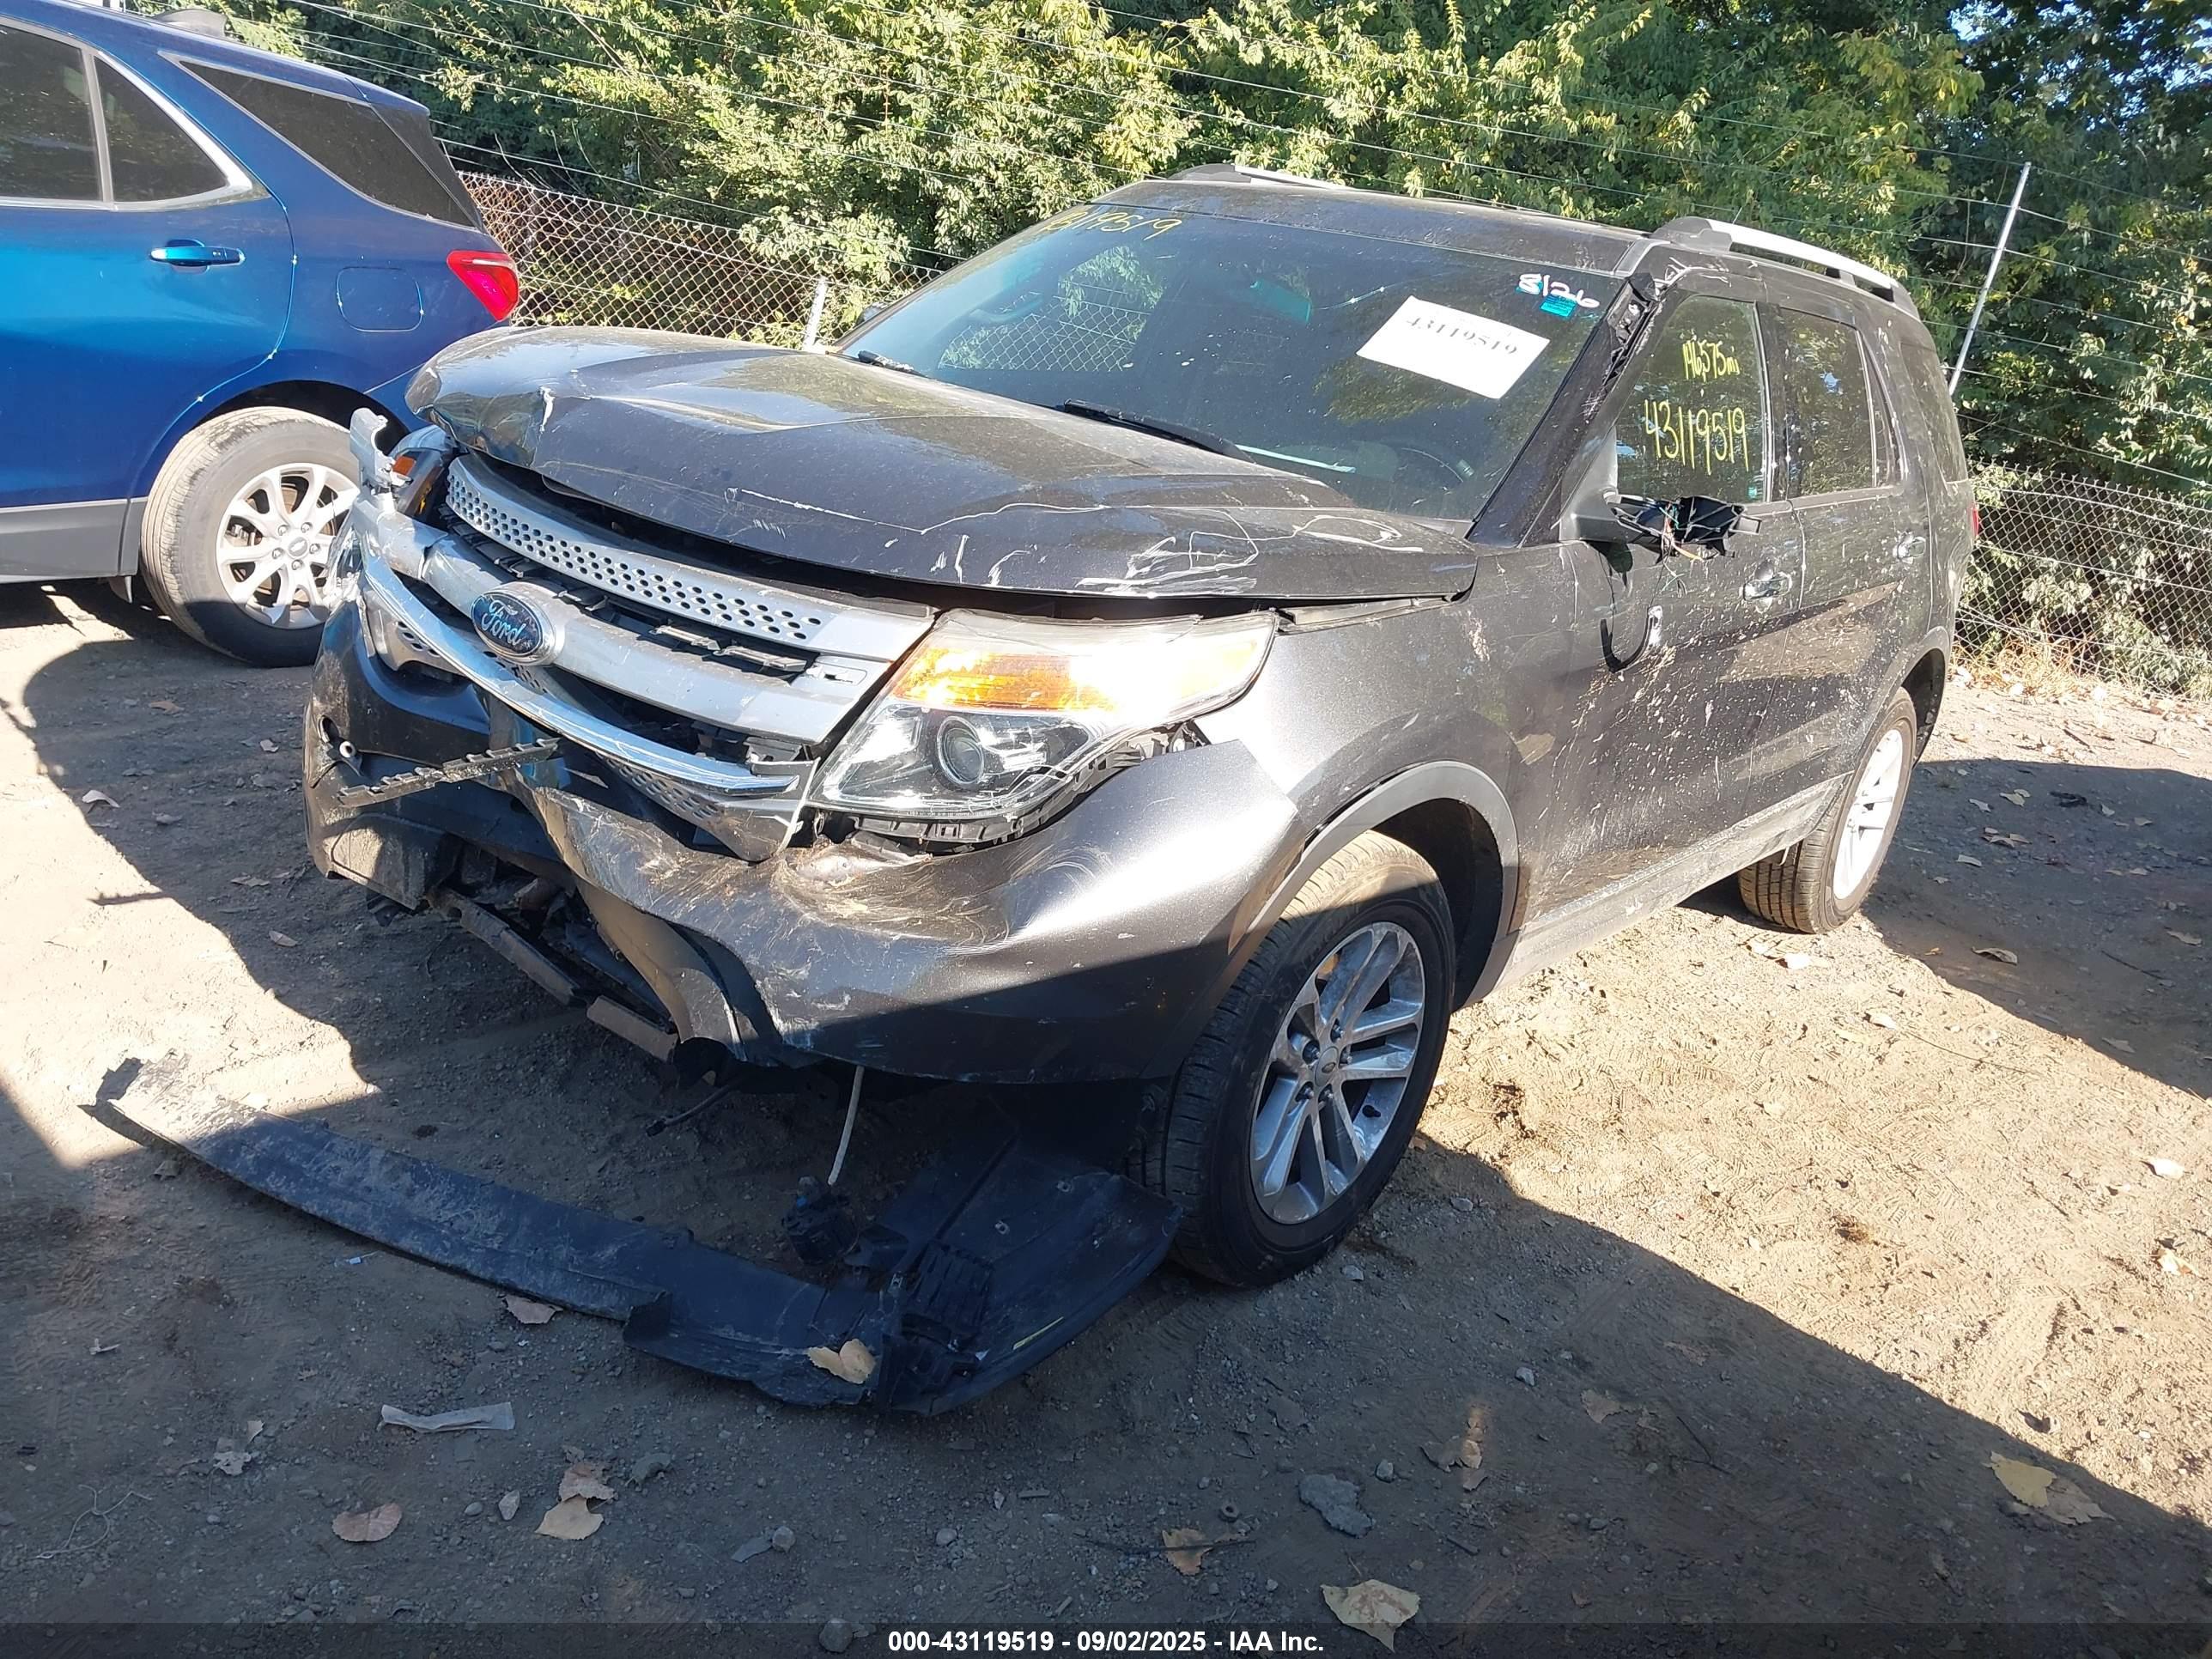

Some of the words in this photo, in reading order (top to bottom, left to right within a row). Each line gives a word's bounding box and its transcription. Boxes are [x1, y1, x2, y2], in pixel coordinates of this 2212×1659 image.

[1518, 273, 1600, 308] 8126
[1644, 398, 1750, 476] 43119519
[481, 599, 526, 647] Ford
